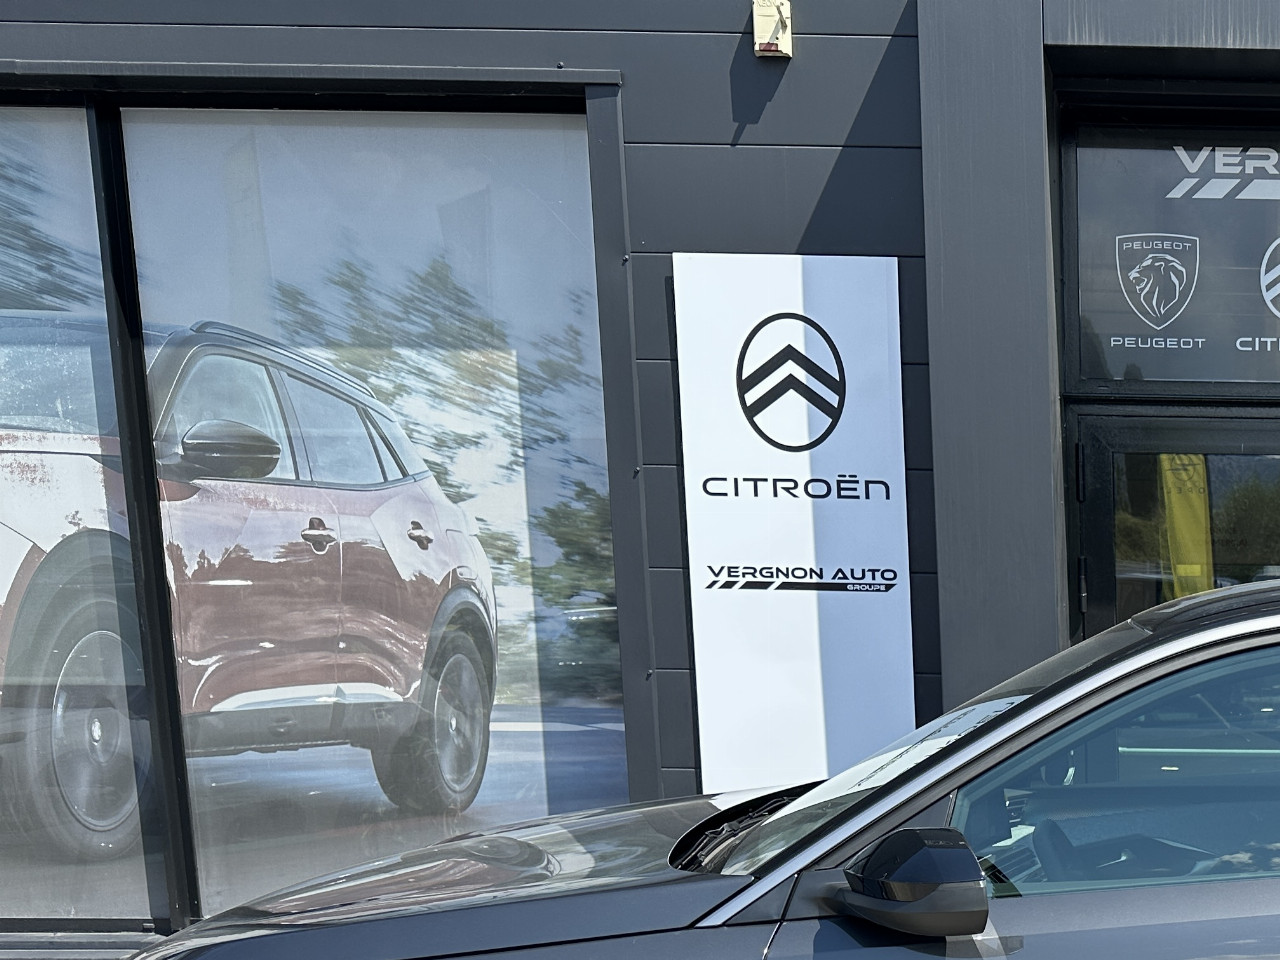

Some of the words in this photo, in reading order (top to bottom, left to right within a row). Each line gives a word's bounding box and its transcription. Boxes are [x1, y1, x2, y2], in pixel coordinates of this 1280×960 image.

[1123, 240, 1193, 252] PEUGEOT
[1110, 336, 1207, 349] PEUGEOT
[702, 474, 891, 501] CITROËN
[706, 565, 824, 581] VERGNON
[831, 567, 898, 582] AUTO
[847, 584, 886, 592] GROUPE
